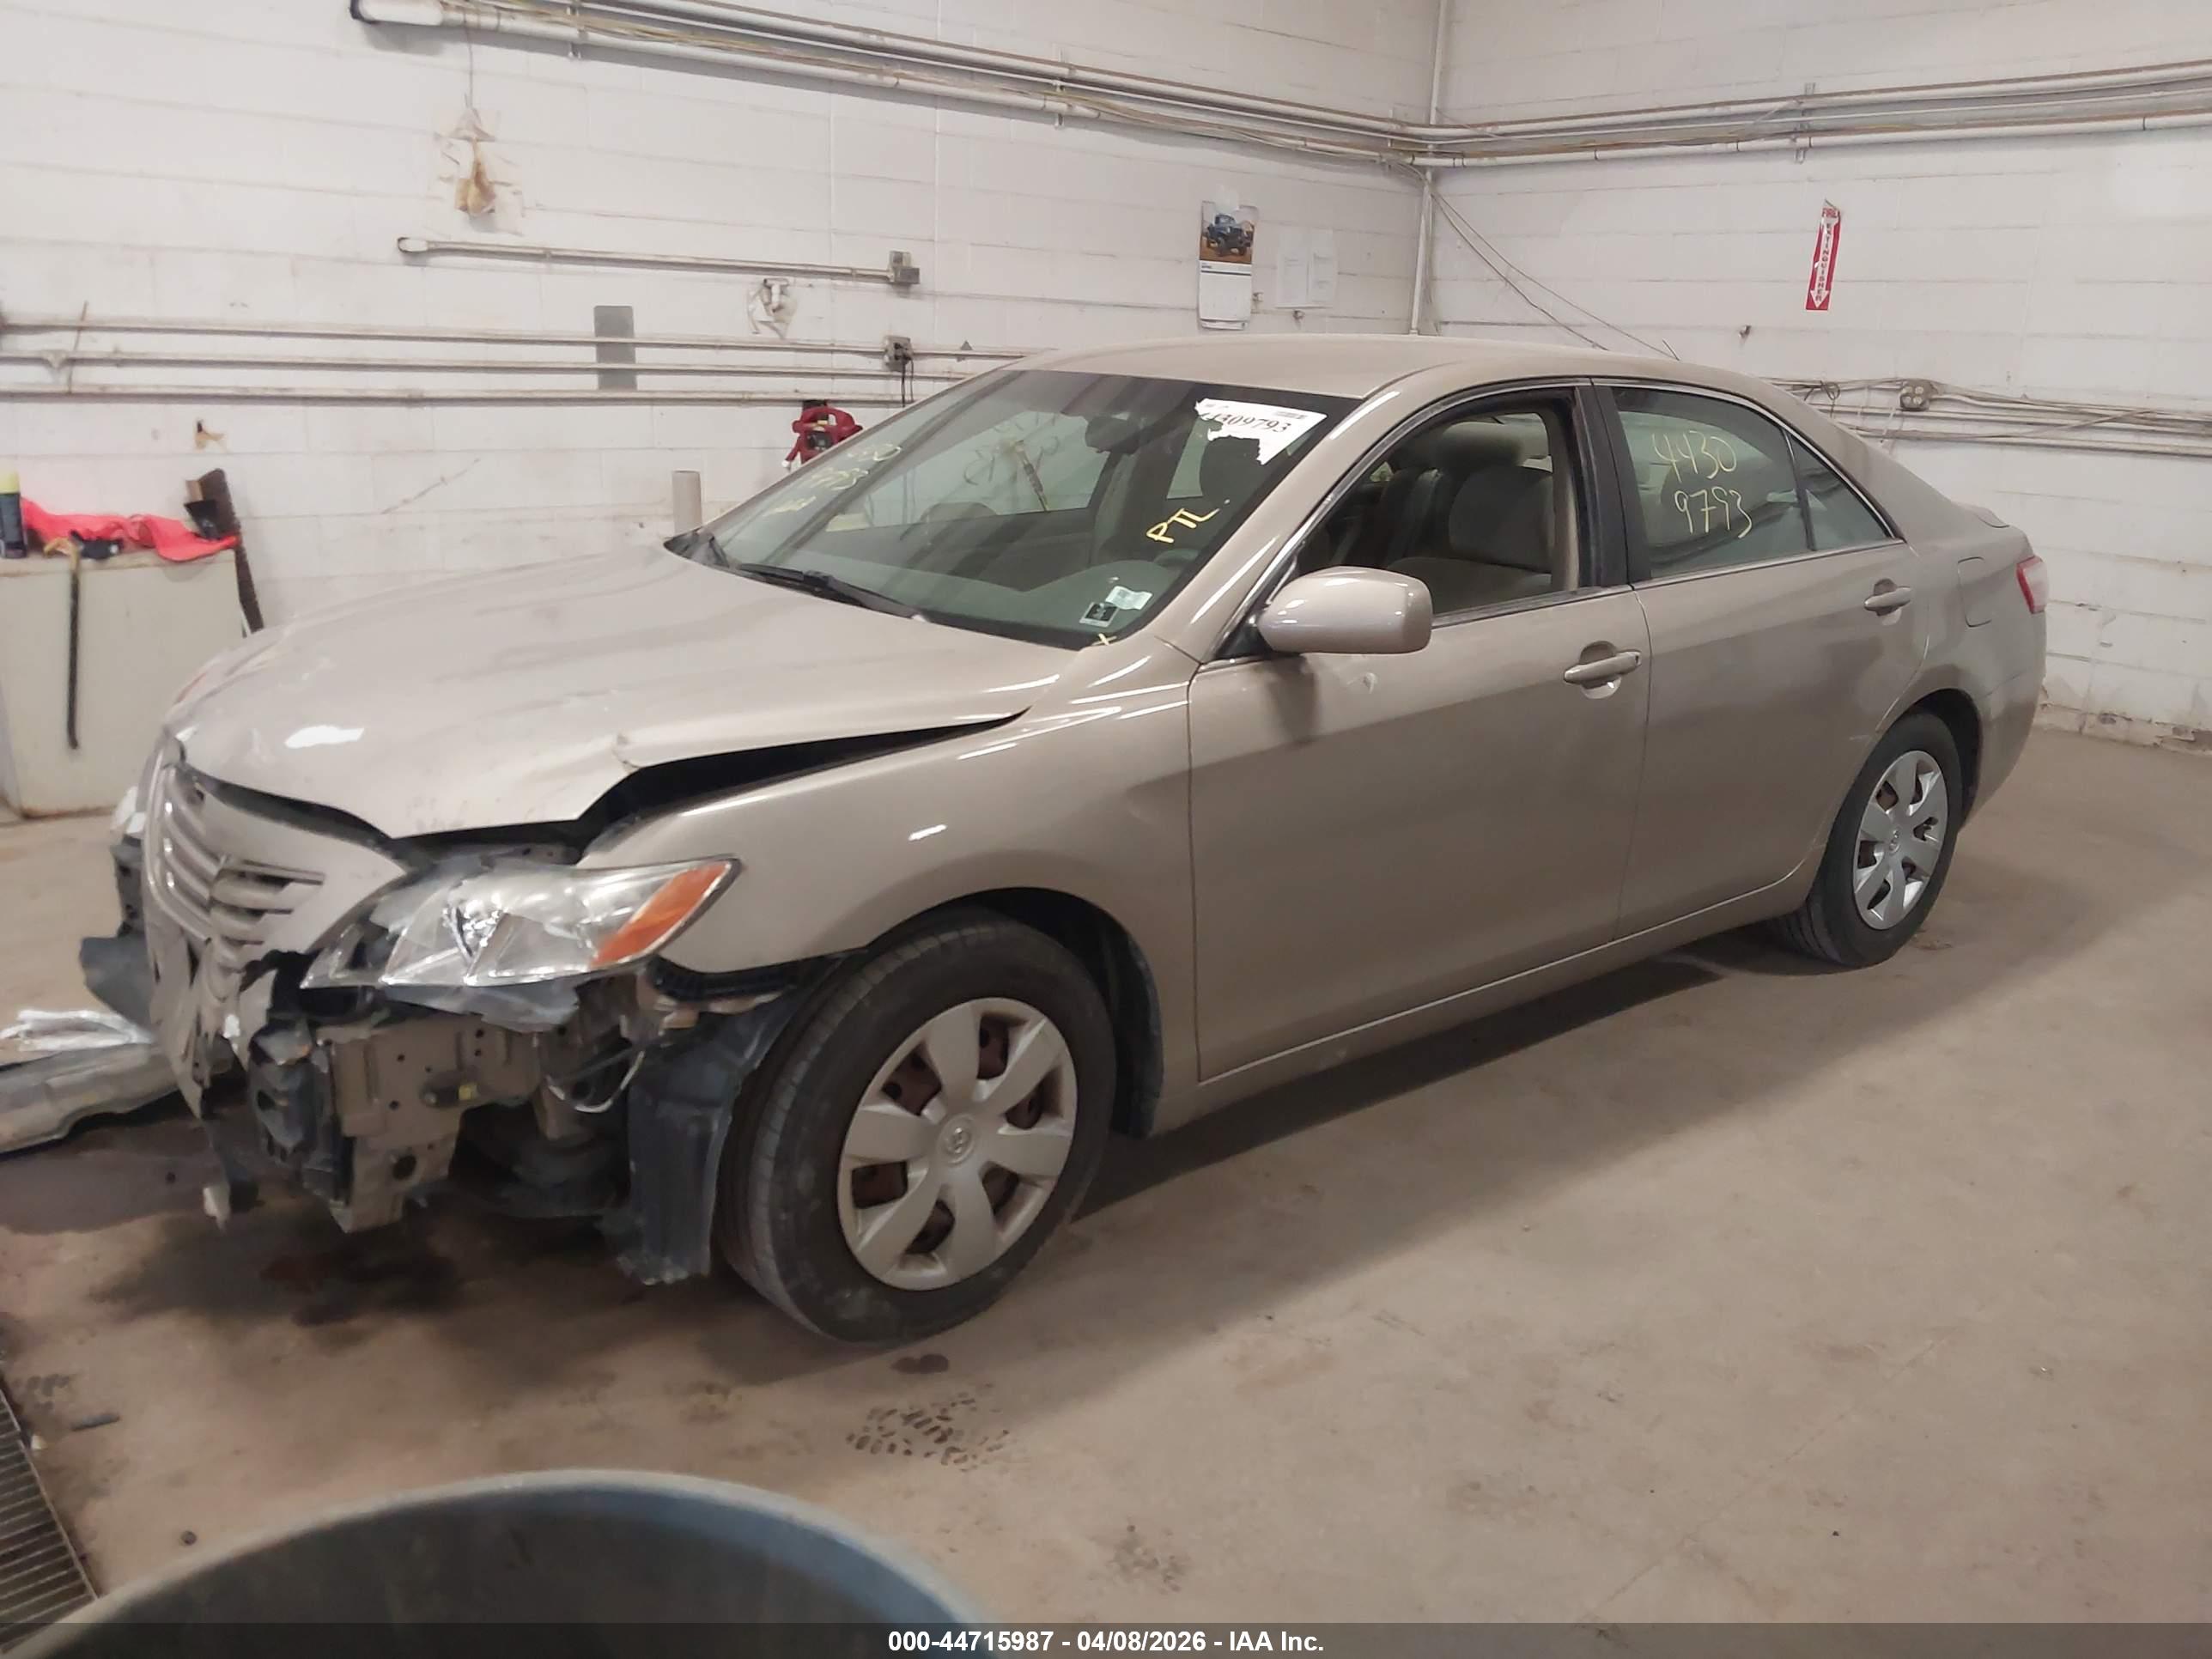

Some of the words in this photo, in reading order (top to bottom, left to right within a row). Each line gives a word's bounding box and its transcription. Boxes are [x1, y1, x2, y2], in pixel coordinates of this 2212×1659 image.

[1815, 223, 1832, 301] EXTINGUISHER
[1651, 430, 1737, 483] 4430
[1674, 486, 1753, 538] 9793
